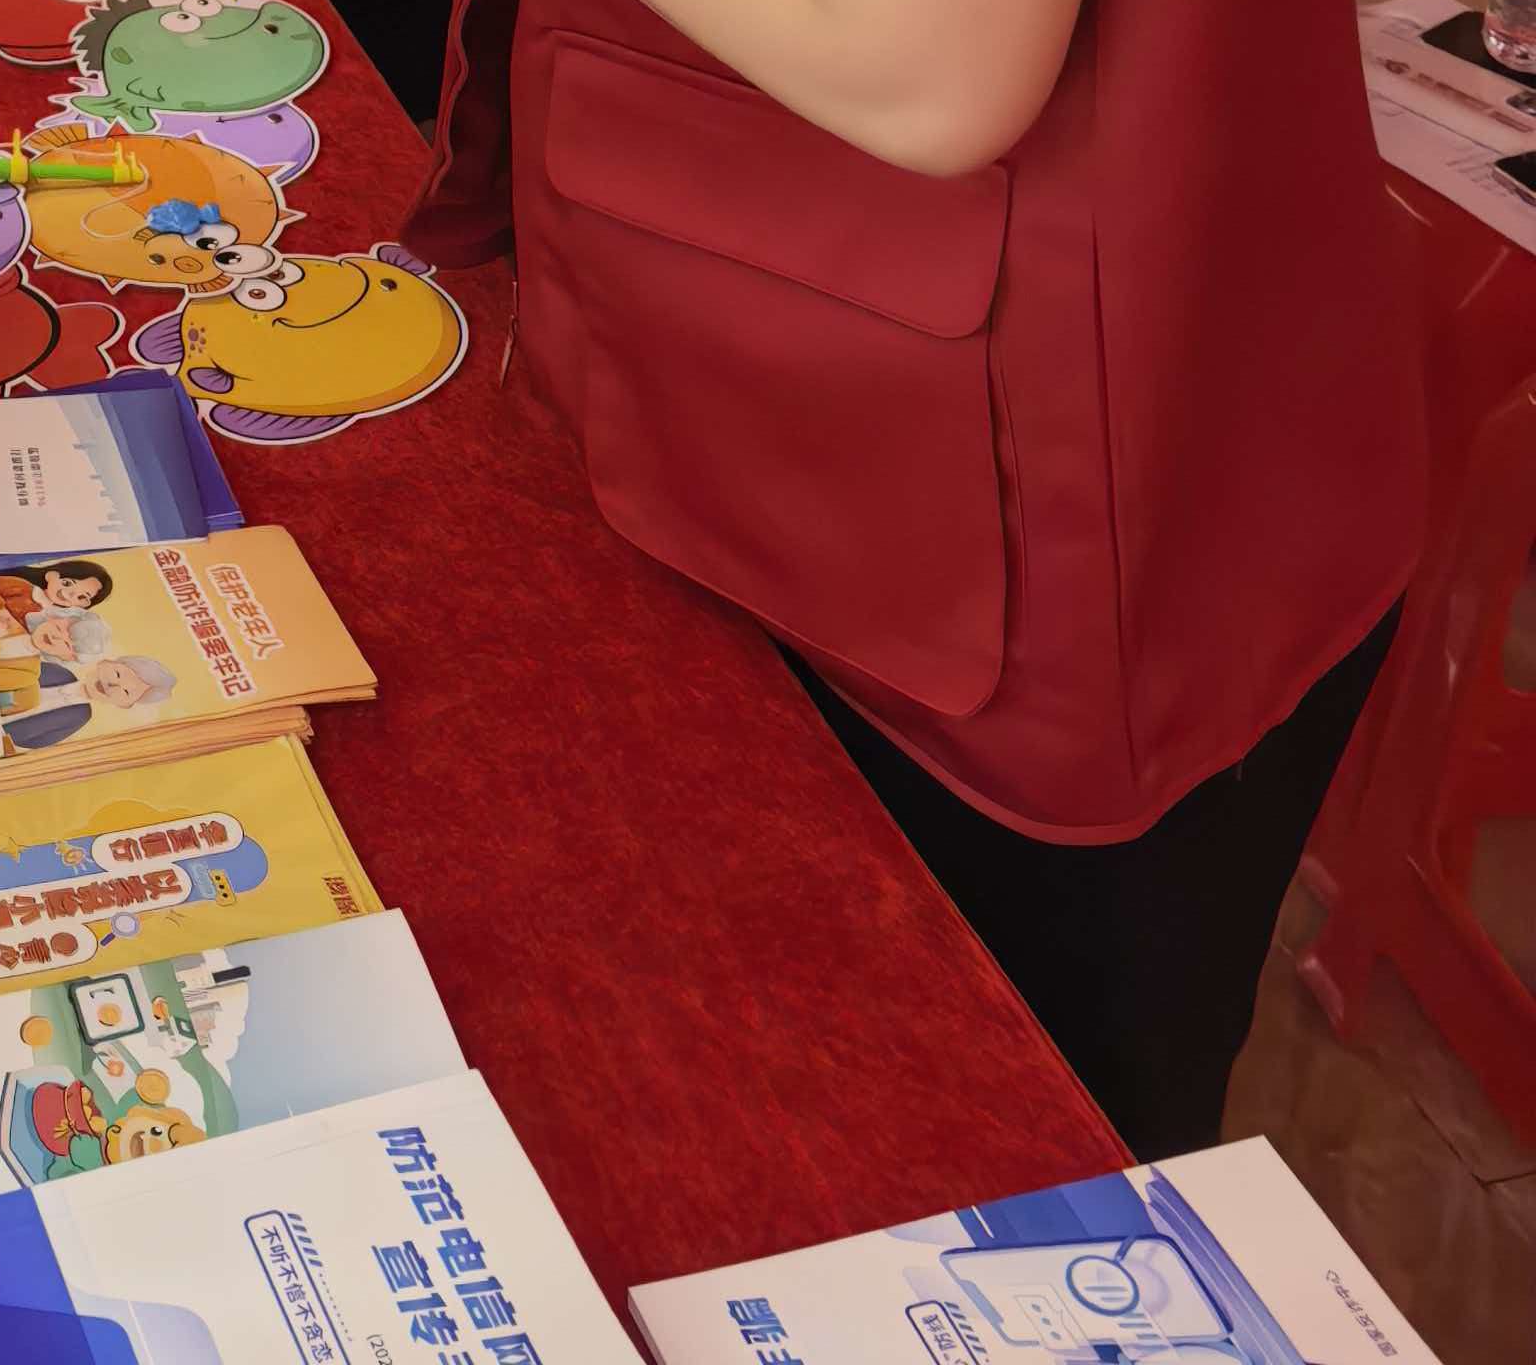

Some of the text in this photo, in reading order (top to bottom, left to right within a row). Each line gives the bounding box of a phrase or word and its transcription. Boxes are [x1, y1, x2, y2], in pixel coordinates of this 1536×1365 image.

[153, 548, 252, 697] 金融防诈骗要牢记
[209, 566, 283, 659] 保护老年人
[261, 1225, 334, 1363] 不听不信不贪恋
[376, 1126, 545, 1365] 防范电信网
